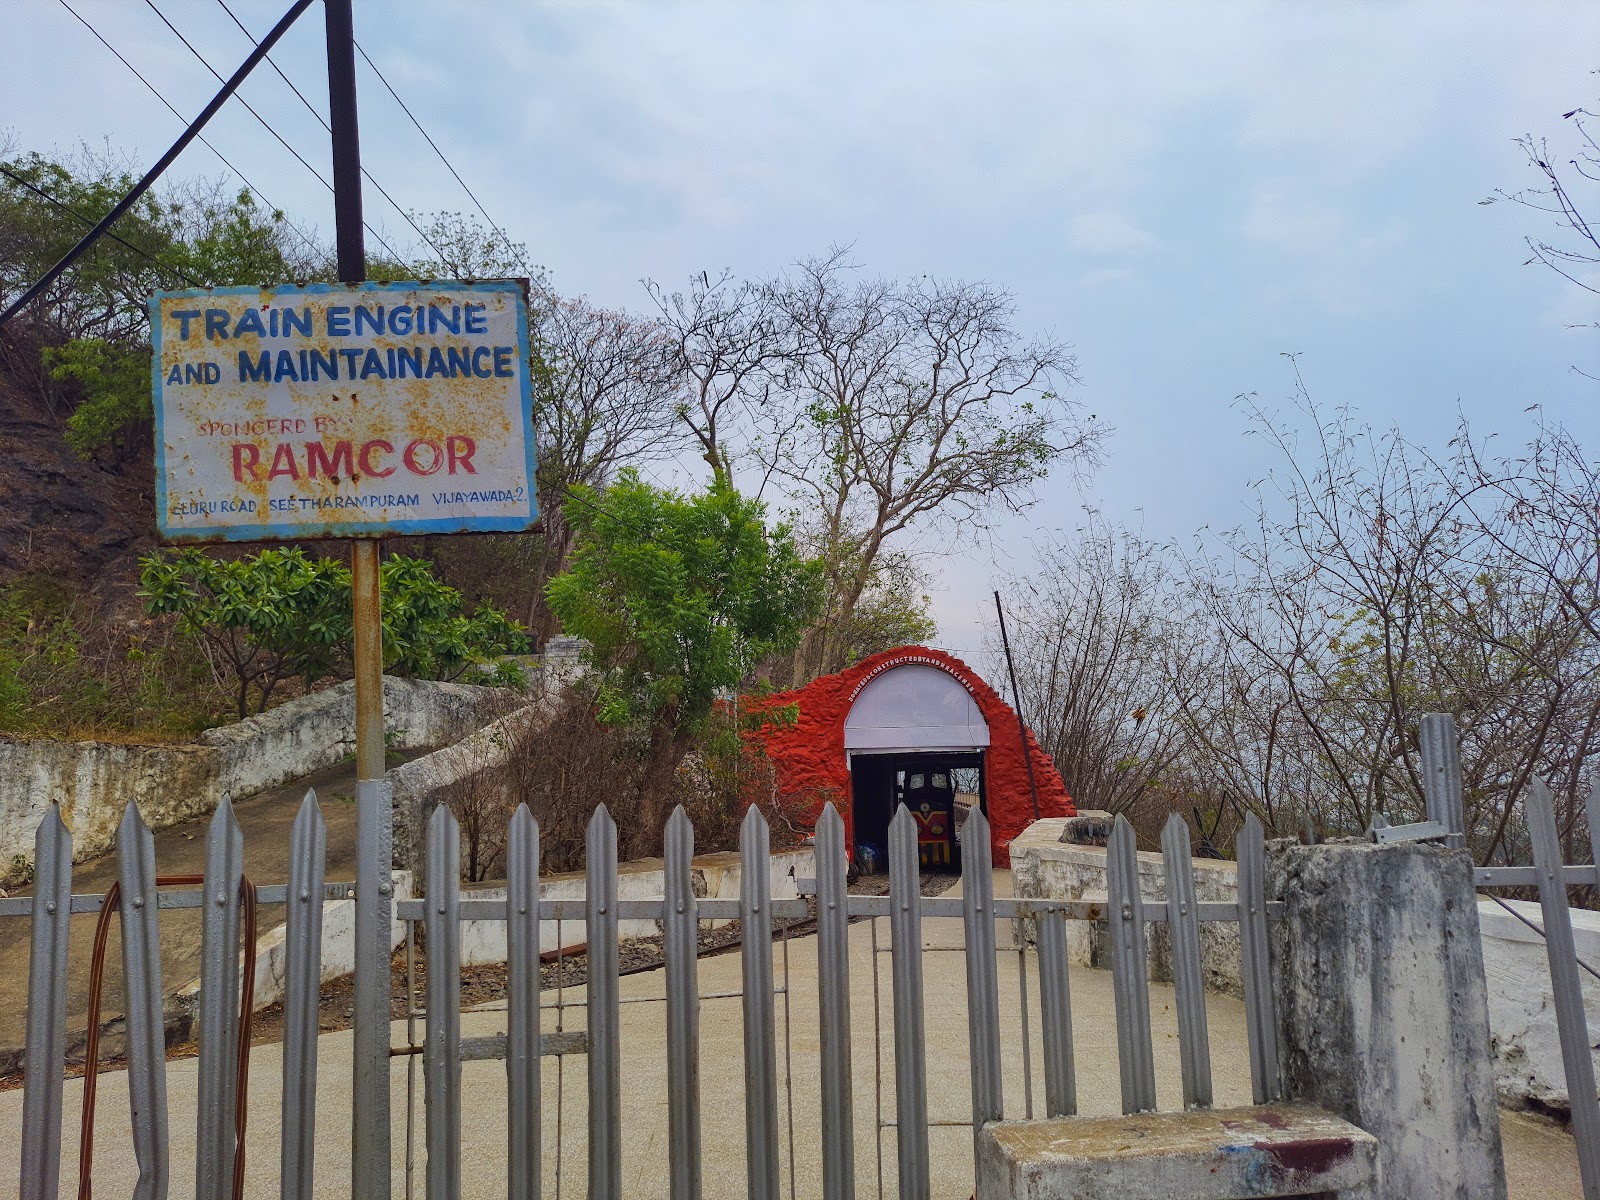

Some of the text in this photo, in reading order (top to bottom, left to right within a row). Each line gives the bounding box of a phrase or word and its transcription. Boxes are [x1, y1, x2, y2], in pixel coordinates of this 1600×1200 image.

[171, 304, 489, 341] TRAIN ENGINE
[166, 346, 515, 386] AND MAINTAINANCE
[231, 435, 479, 483] RAMCOR
